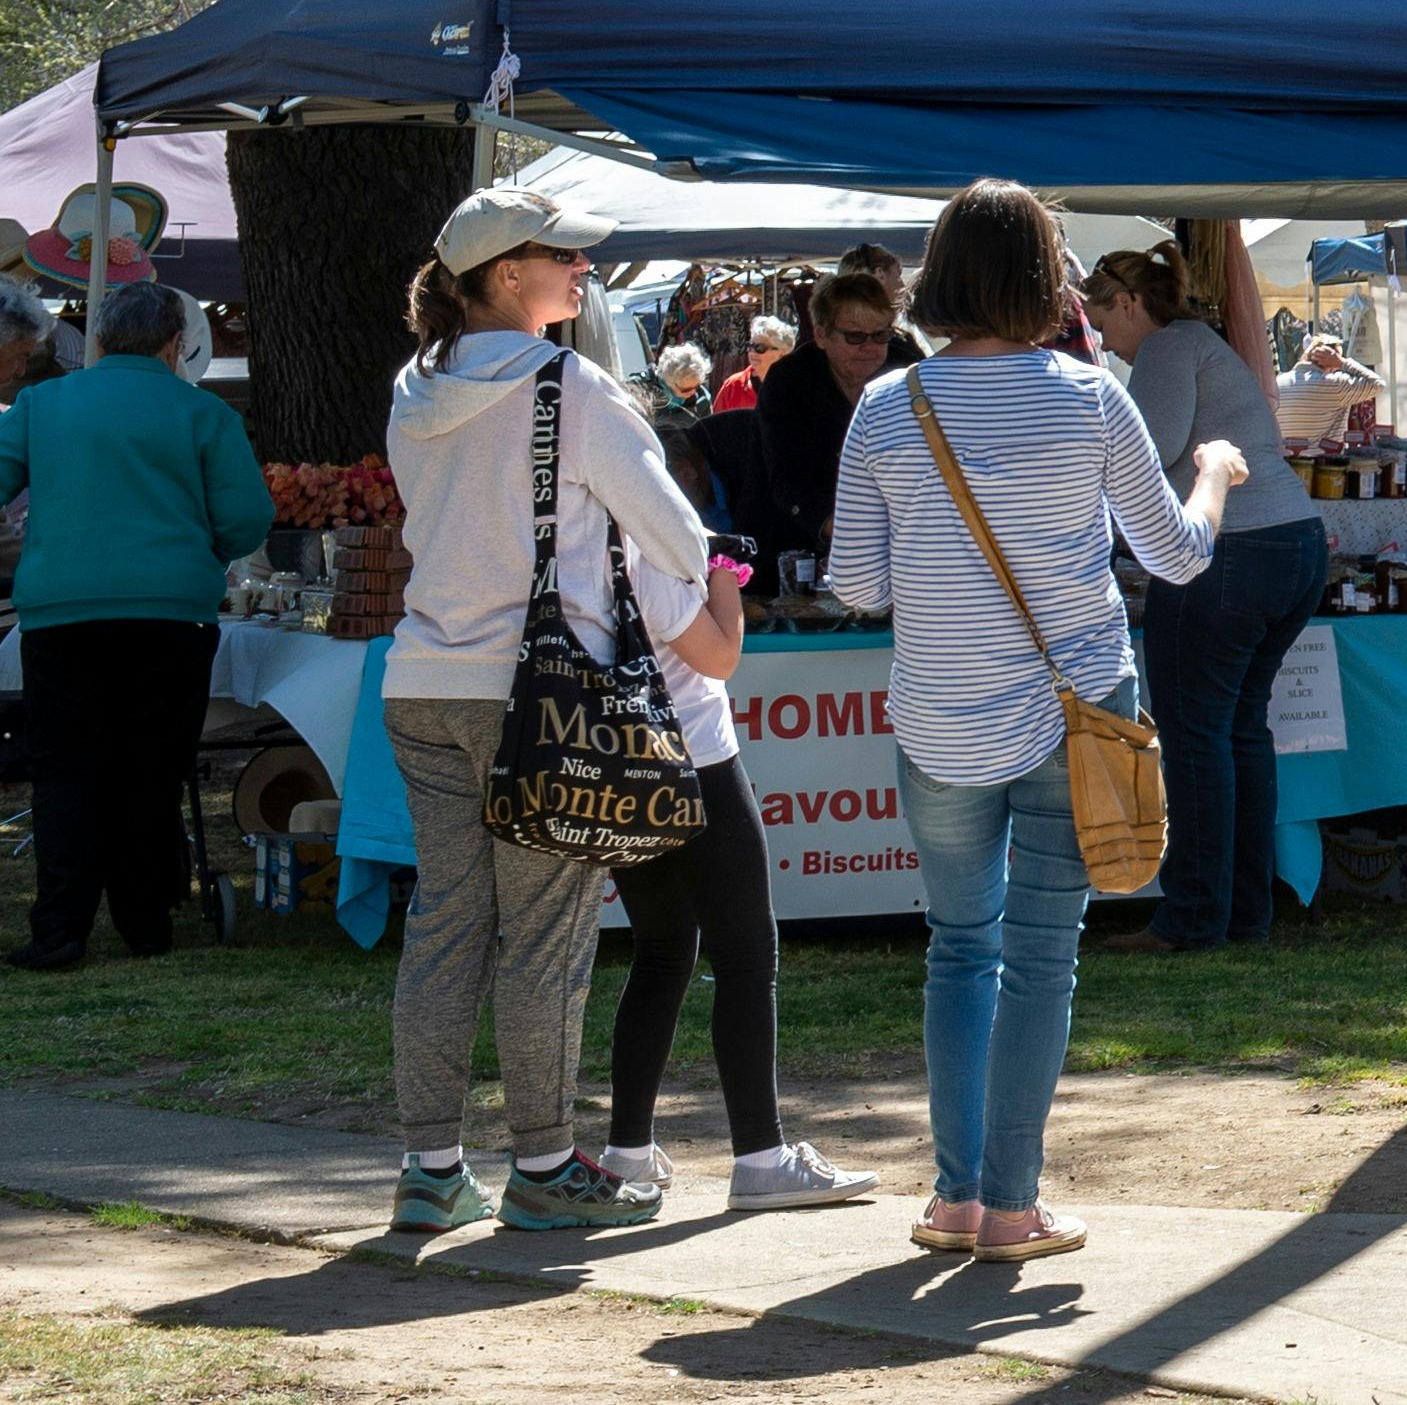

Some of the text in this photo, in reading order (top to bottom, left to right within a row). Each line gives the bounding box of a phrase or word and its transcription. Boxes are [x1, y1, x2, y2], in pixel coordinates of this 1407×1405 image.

[1303, 643, 1327, 652] FREE
[1287, 689, 1314, 699] SLICE
[1278, 710, 1328, 722] AVAILABLE
[536, 696, 691, 762] Monac
[559, 757, 602, 780] Nice
[516, 770, 638, 824] Monte
[593, 827, 662, 850] Tropez
[802, 847, 920, 876] Biscuits
